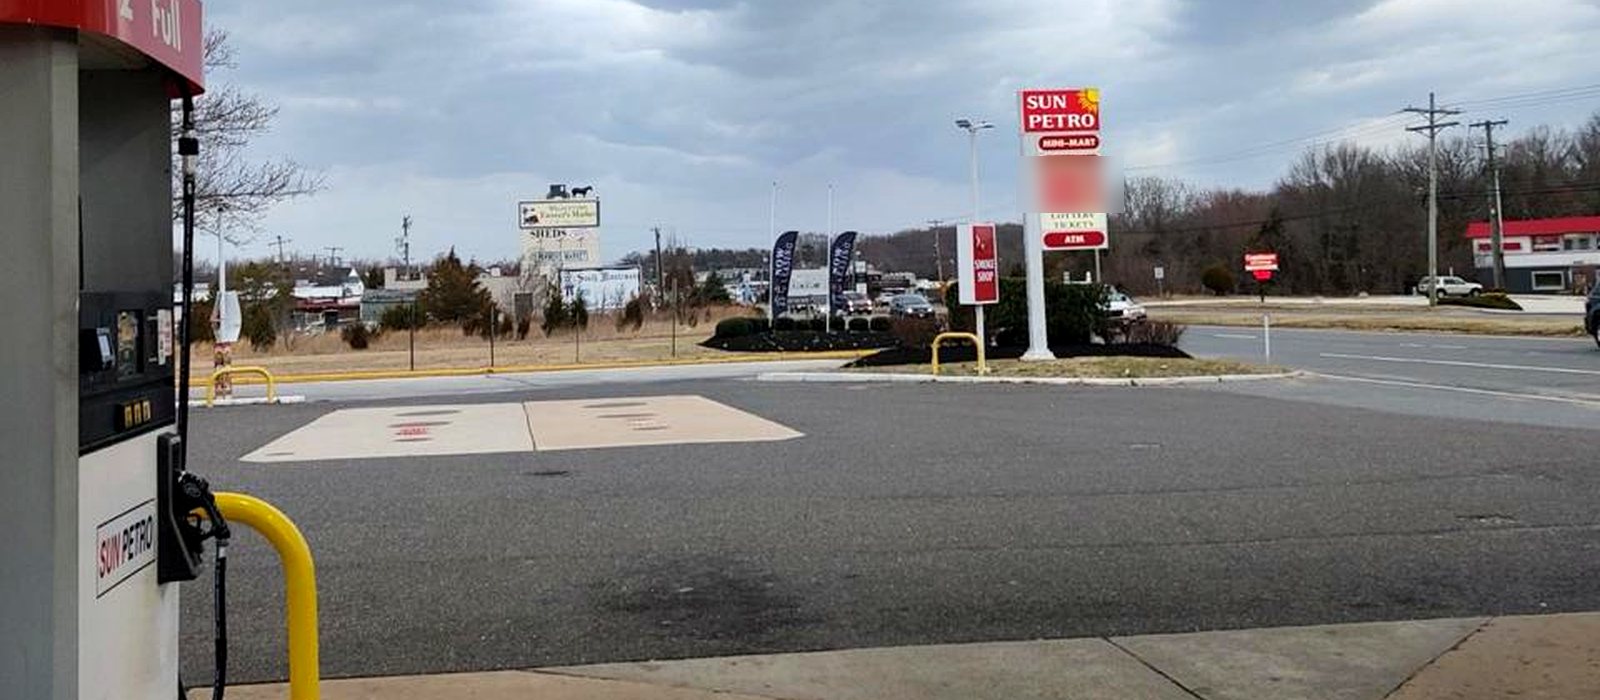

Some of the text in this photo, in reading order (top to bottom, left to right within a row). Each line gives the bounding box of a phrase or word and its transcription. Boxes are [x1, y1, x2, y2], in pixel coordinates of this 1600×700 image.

[150, 0, 181, 52] Full
[1026, 95, 1066, 109] SUN
[1028, 113, 1095, 128] PETRO
[1042, 138, 1097, 148] MINI-MART
[530, 229, 567, 238] SHEDS
[1064, 234, 1086, 244] ATM
[973, 259, 996, 269] SMOKE
[977, 271, 994, 283] SHOP
[100, 515, 153, 579] SUN PETRO
